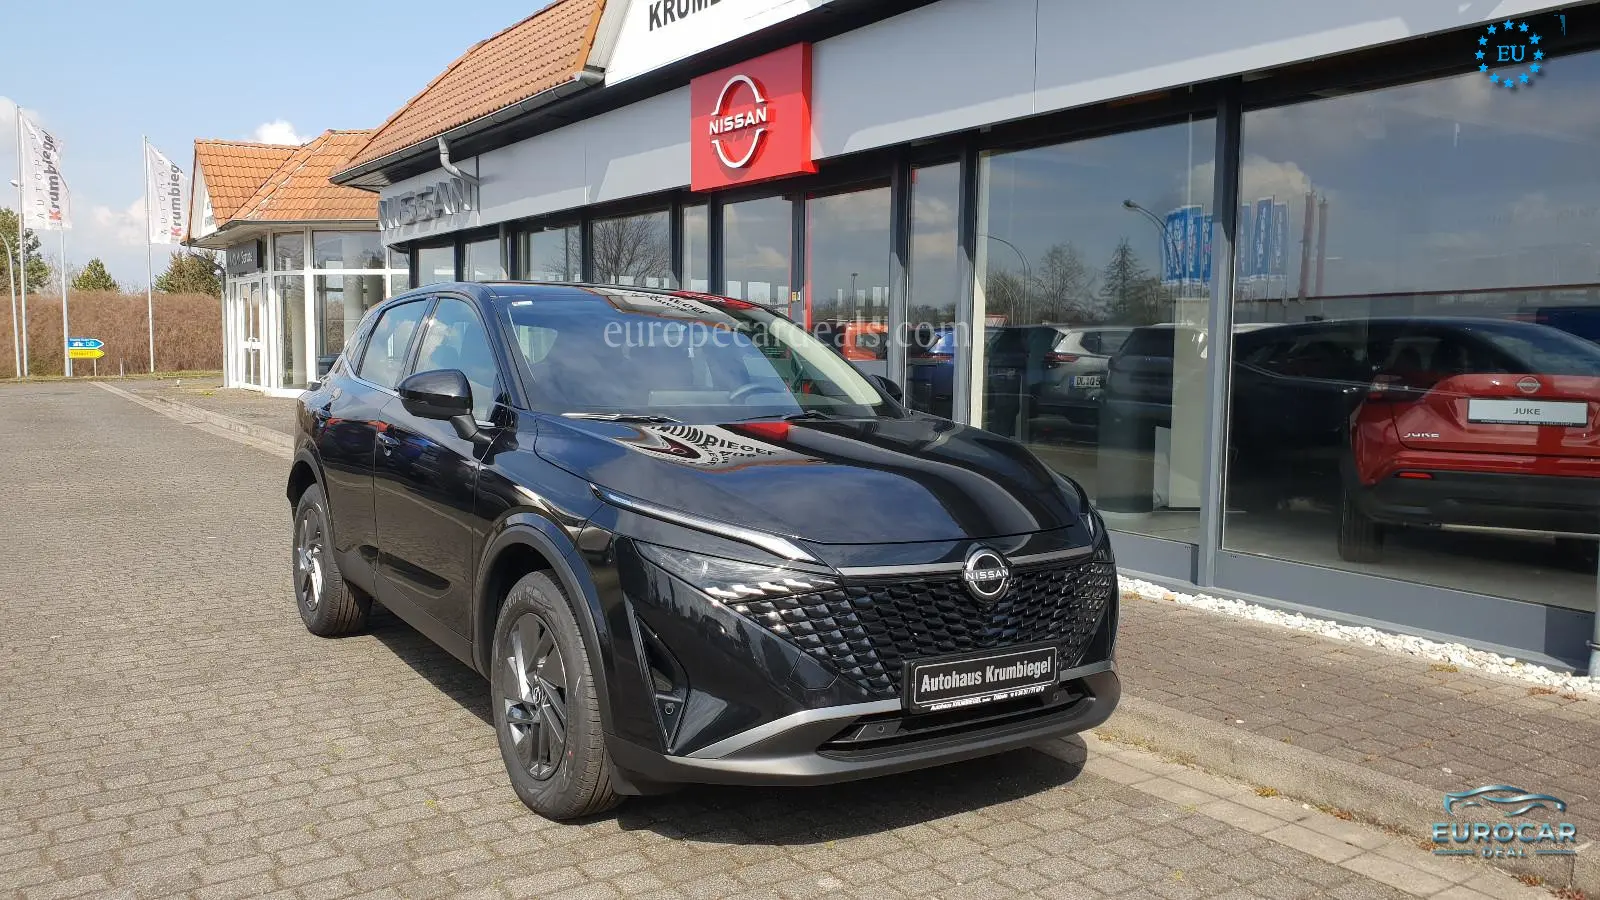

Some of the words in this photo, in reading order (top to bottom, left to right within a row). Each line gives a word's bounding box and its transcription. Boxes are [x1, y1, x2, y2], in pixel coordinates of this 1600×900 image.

[649, 0, 722, 32] KRU
[709, 106, 767, 136] NISSAN
[1513, 407, 1541, 416] JUKE
[965, 568, 1009, 581] NISSAN
[920, 670, 982, 693] Autohaus
[985, 656, 1052, 683] Krumbiegel
